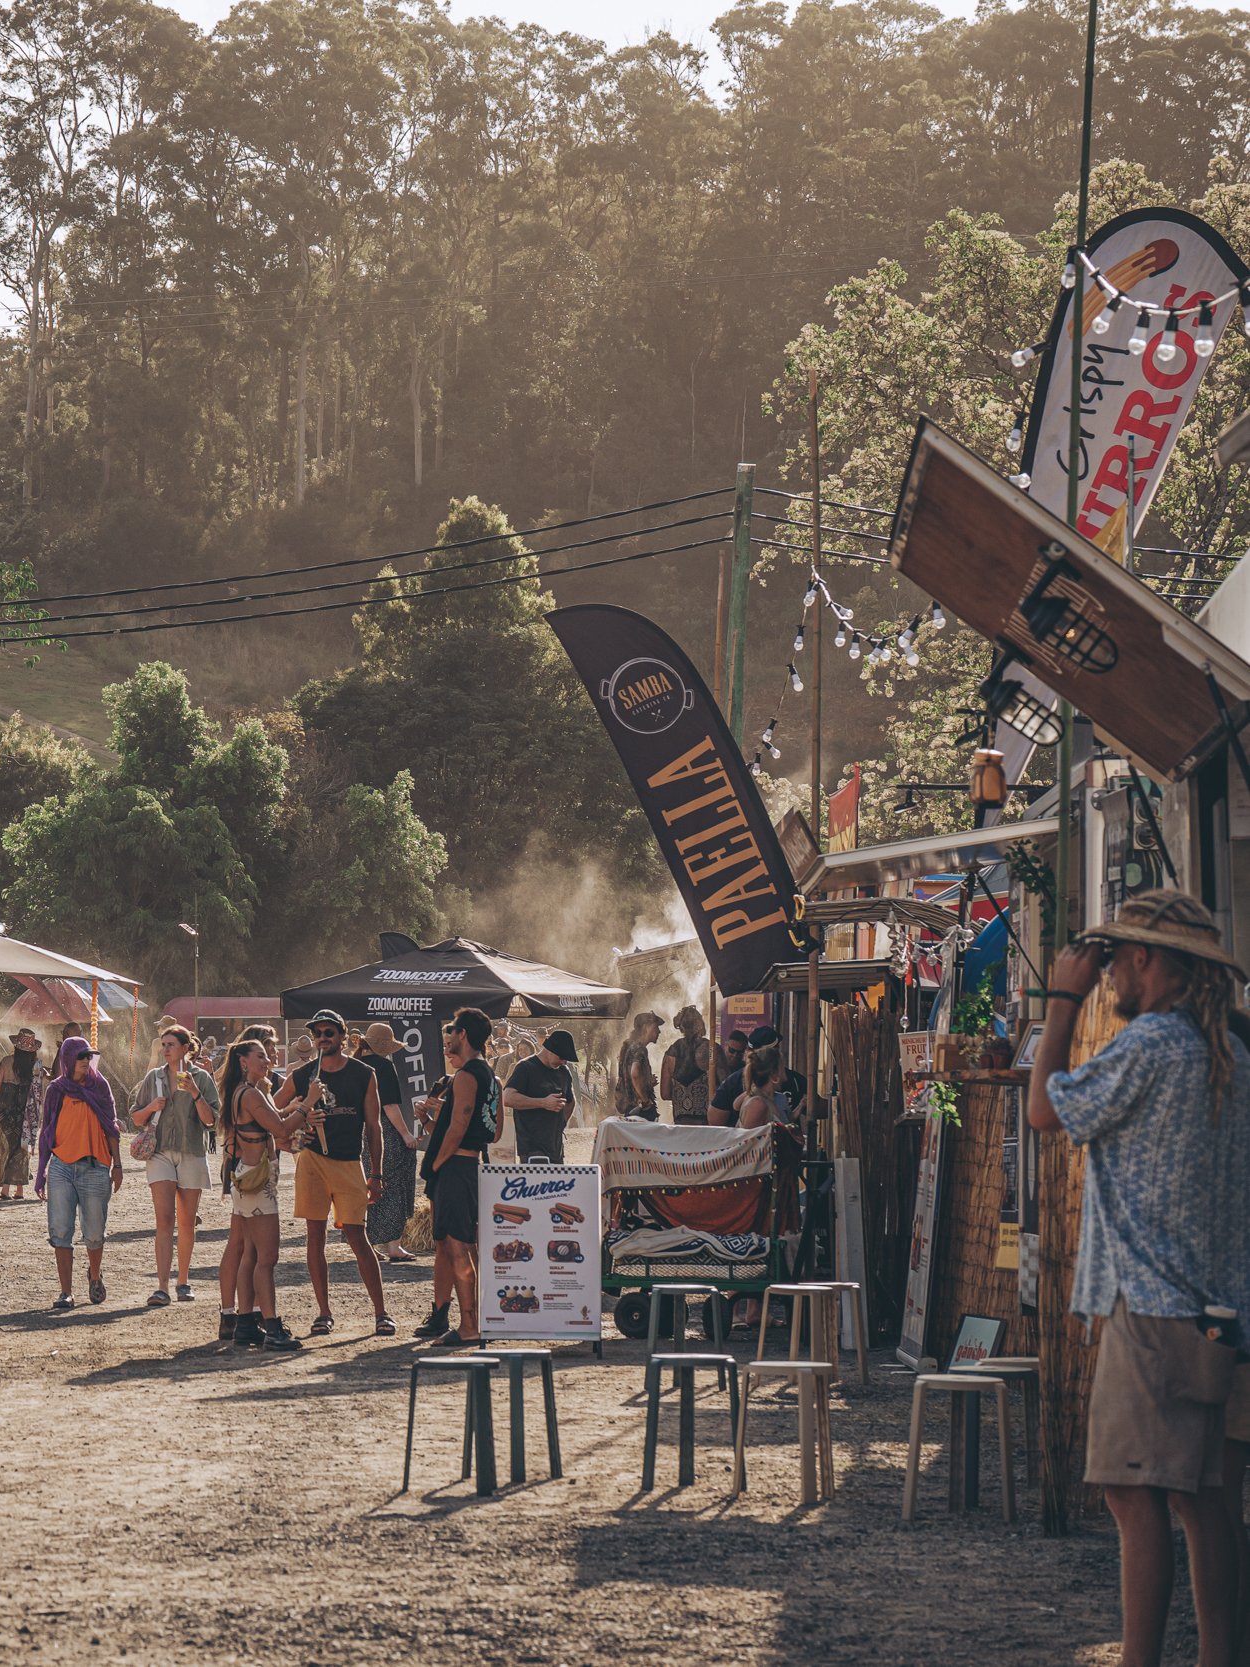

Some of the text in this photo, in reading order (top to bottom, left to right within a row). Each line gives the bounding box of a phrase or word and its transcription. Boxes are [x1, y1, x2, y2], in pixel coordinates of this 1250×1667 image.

[618, 672, 673, 710] SAMBA
[632, 699, 661, 716] CATERING
[647, 735, 788, 950] PAELLA
[374, 969, 468, 981] ZOOMCOFFEE
[368, 998, 432, 1011] ZOOMCOFFEE
[500, 1177, 576, 1200] Churros
[534, 1193, 568, 1201] HANDMADE
